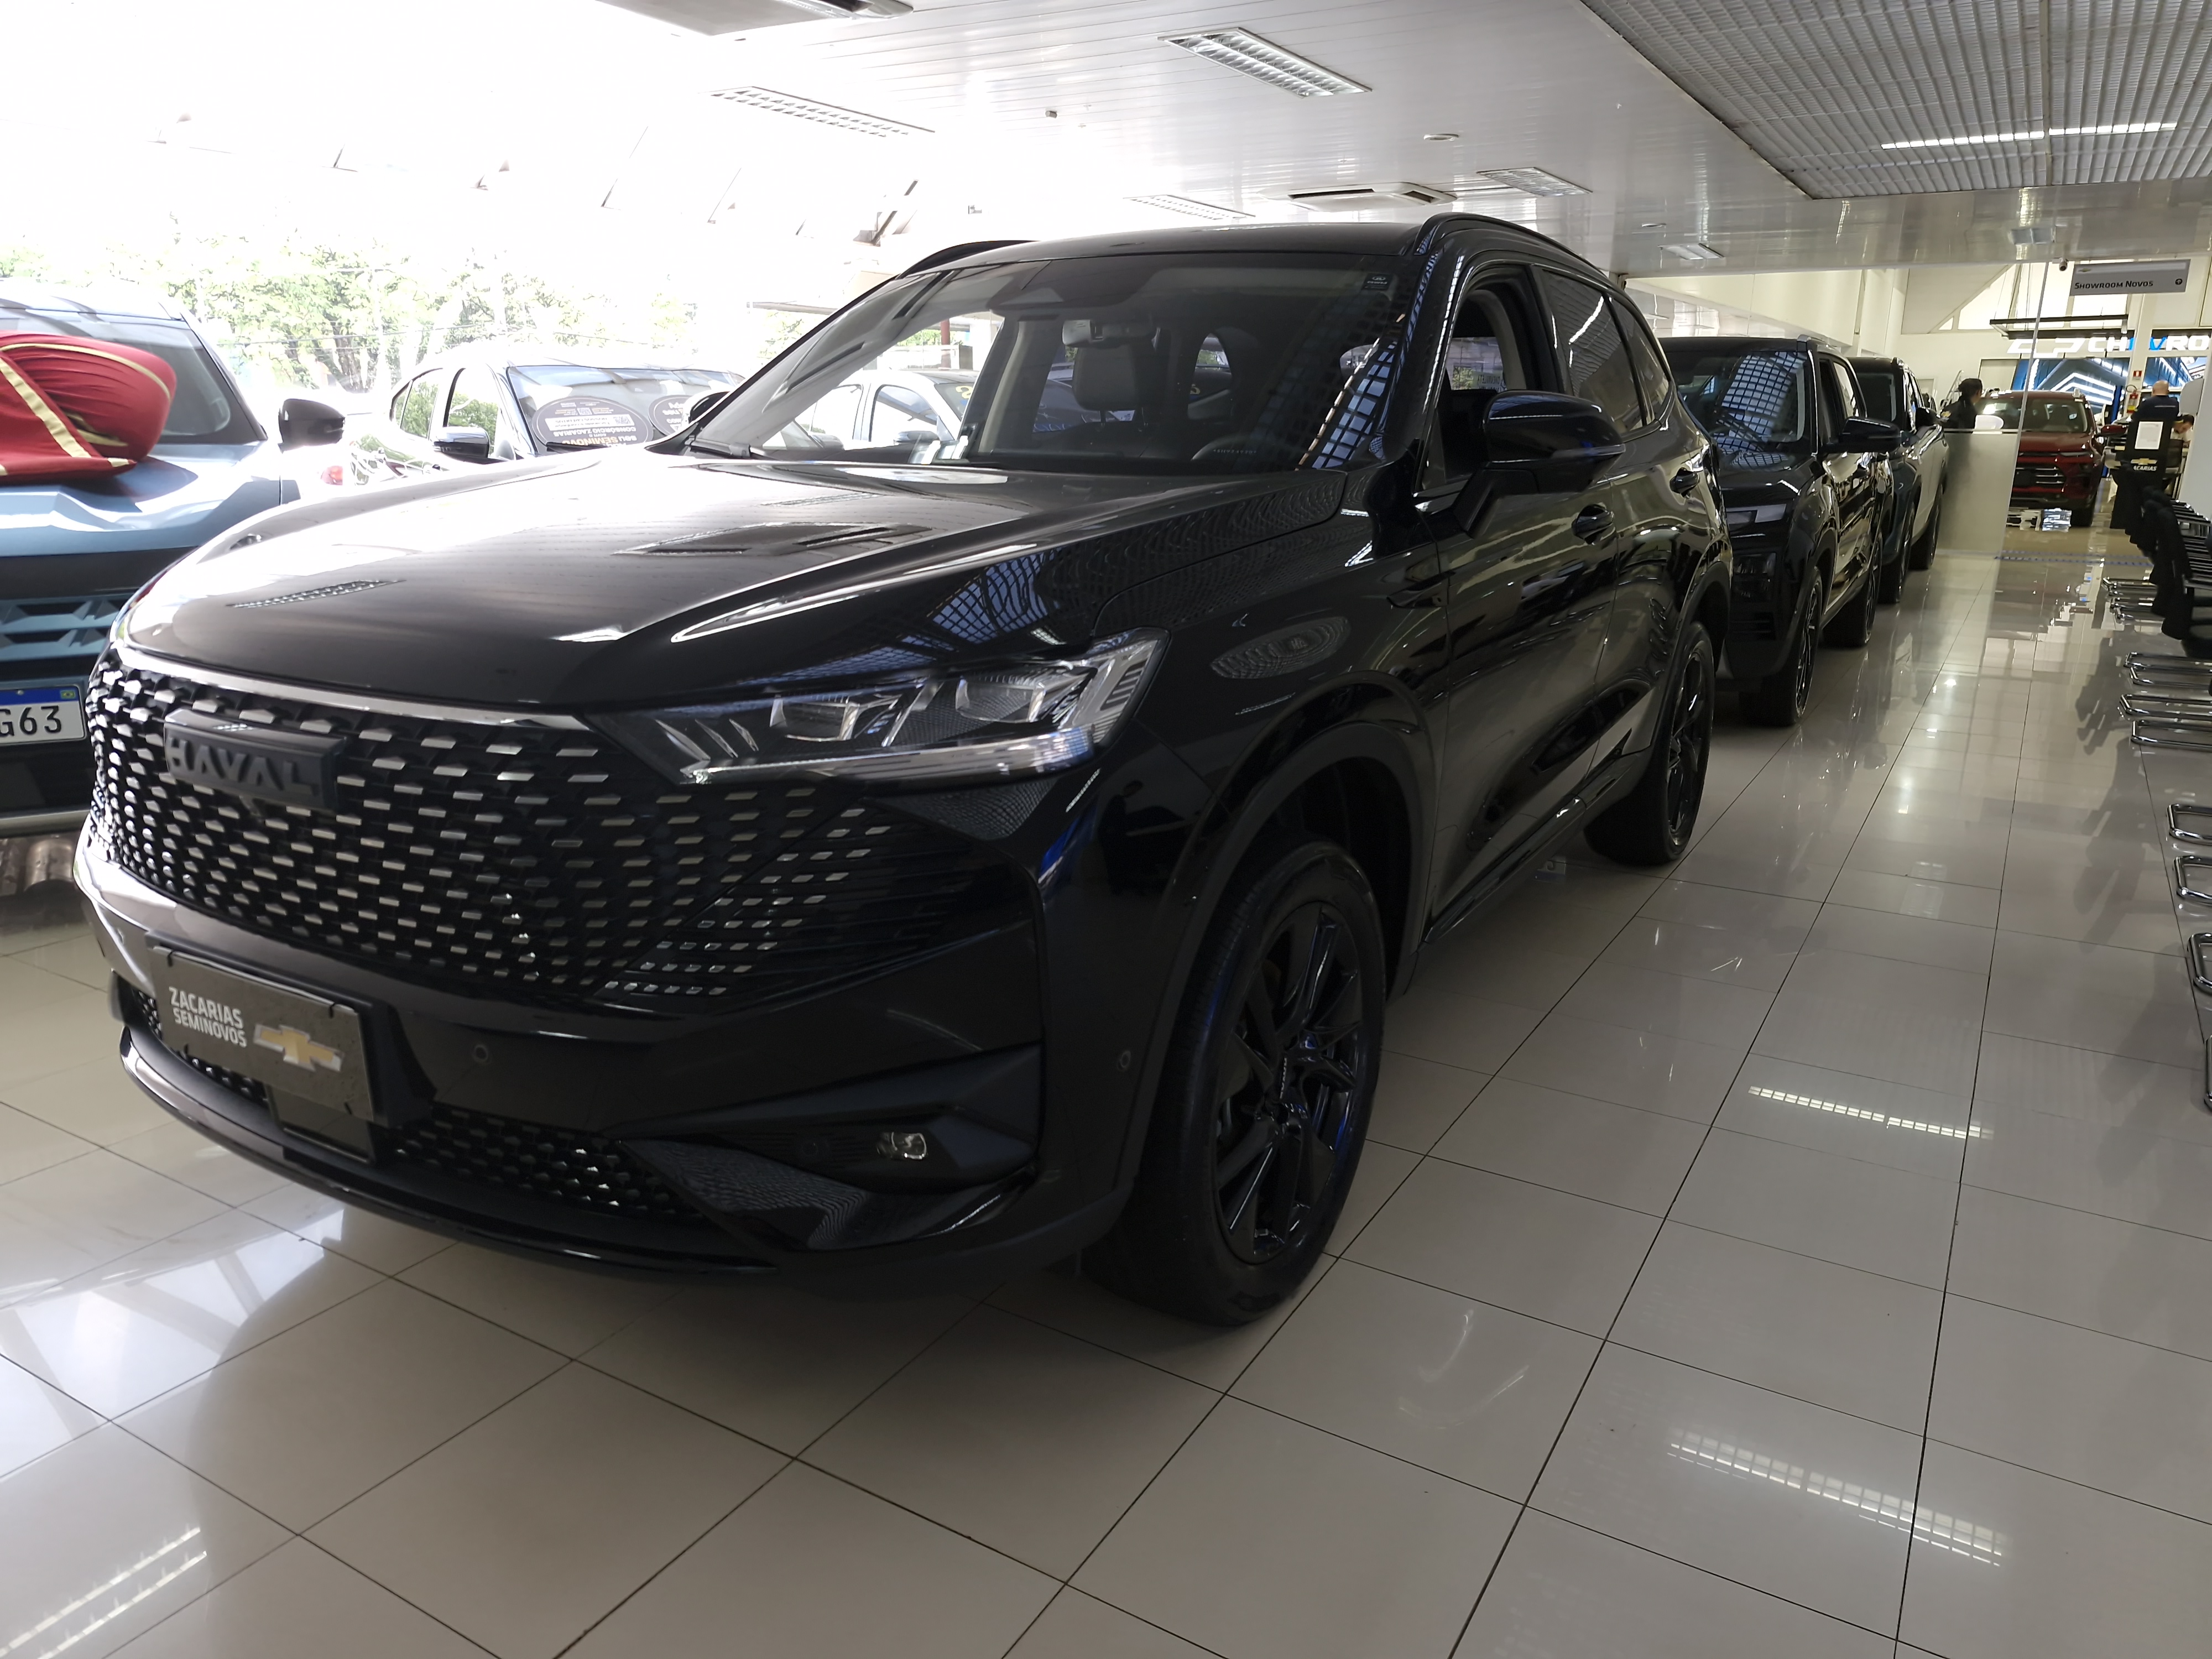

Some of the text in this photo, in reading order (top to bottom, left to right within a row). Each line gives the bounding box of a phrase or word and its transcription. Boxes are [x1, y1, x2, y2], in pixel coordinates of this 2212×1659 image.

[2088, 335, 2210, 353] CHVRO
[0, 705, 62, 737] G63
[166, 737, 315, 795] HAVAL
[169, 987, 243, 1029] ZACARIAS
[173, 1007, 247, 1048] SEMINOVOS
